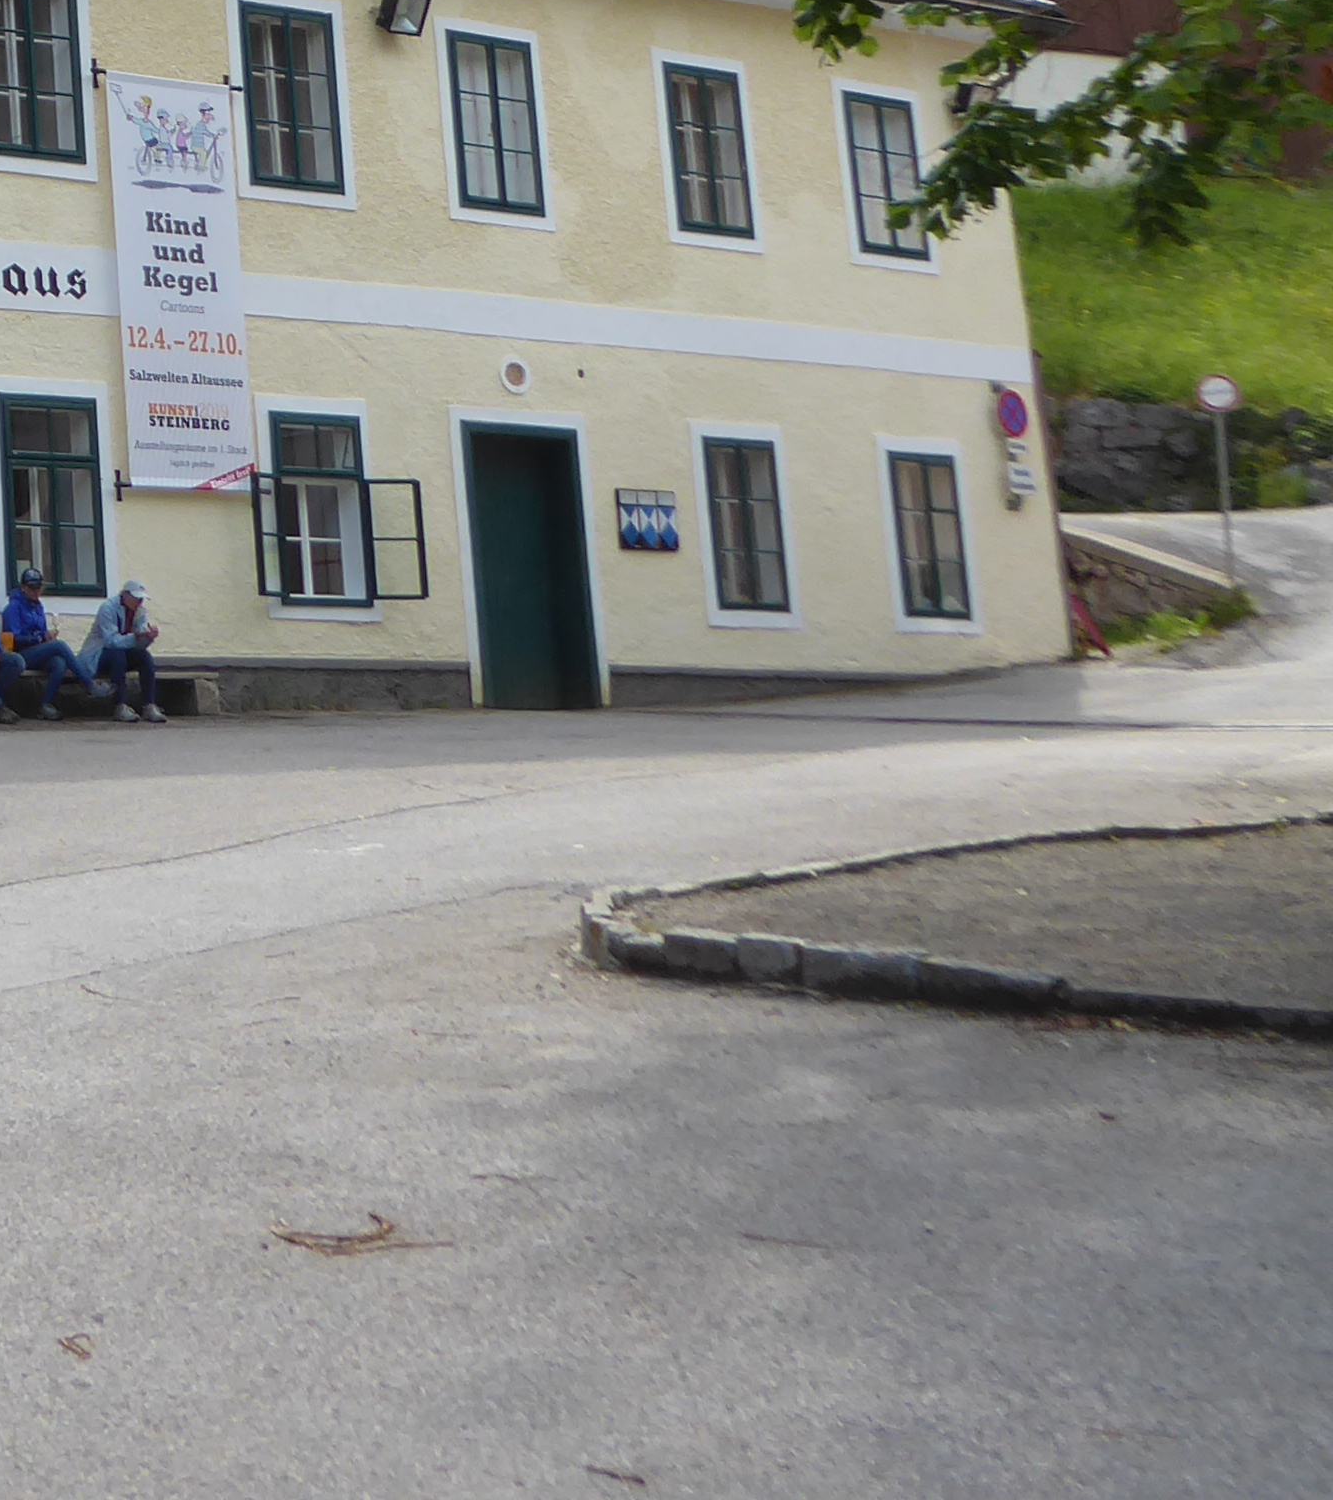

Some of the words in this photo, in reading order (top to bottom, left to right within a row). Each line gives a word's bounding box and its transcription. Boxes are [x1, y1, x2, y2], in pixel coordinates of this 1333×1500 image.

[145, 211, 208, 238] Kind
[152, 243, 205, 264] und
[142, 265, 218, 296] Kegel
[160, 300, 205, 314] Cartoons
[129, 369, 189, 385] Salzwelten
[191, 372, 244, 388] Altaussee
[149, 416, 231, 431] STEINBERG
